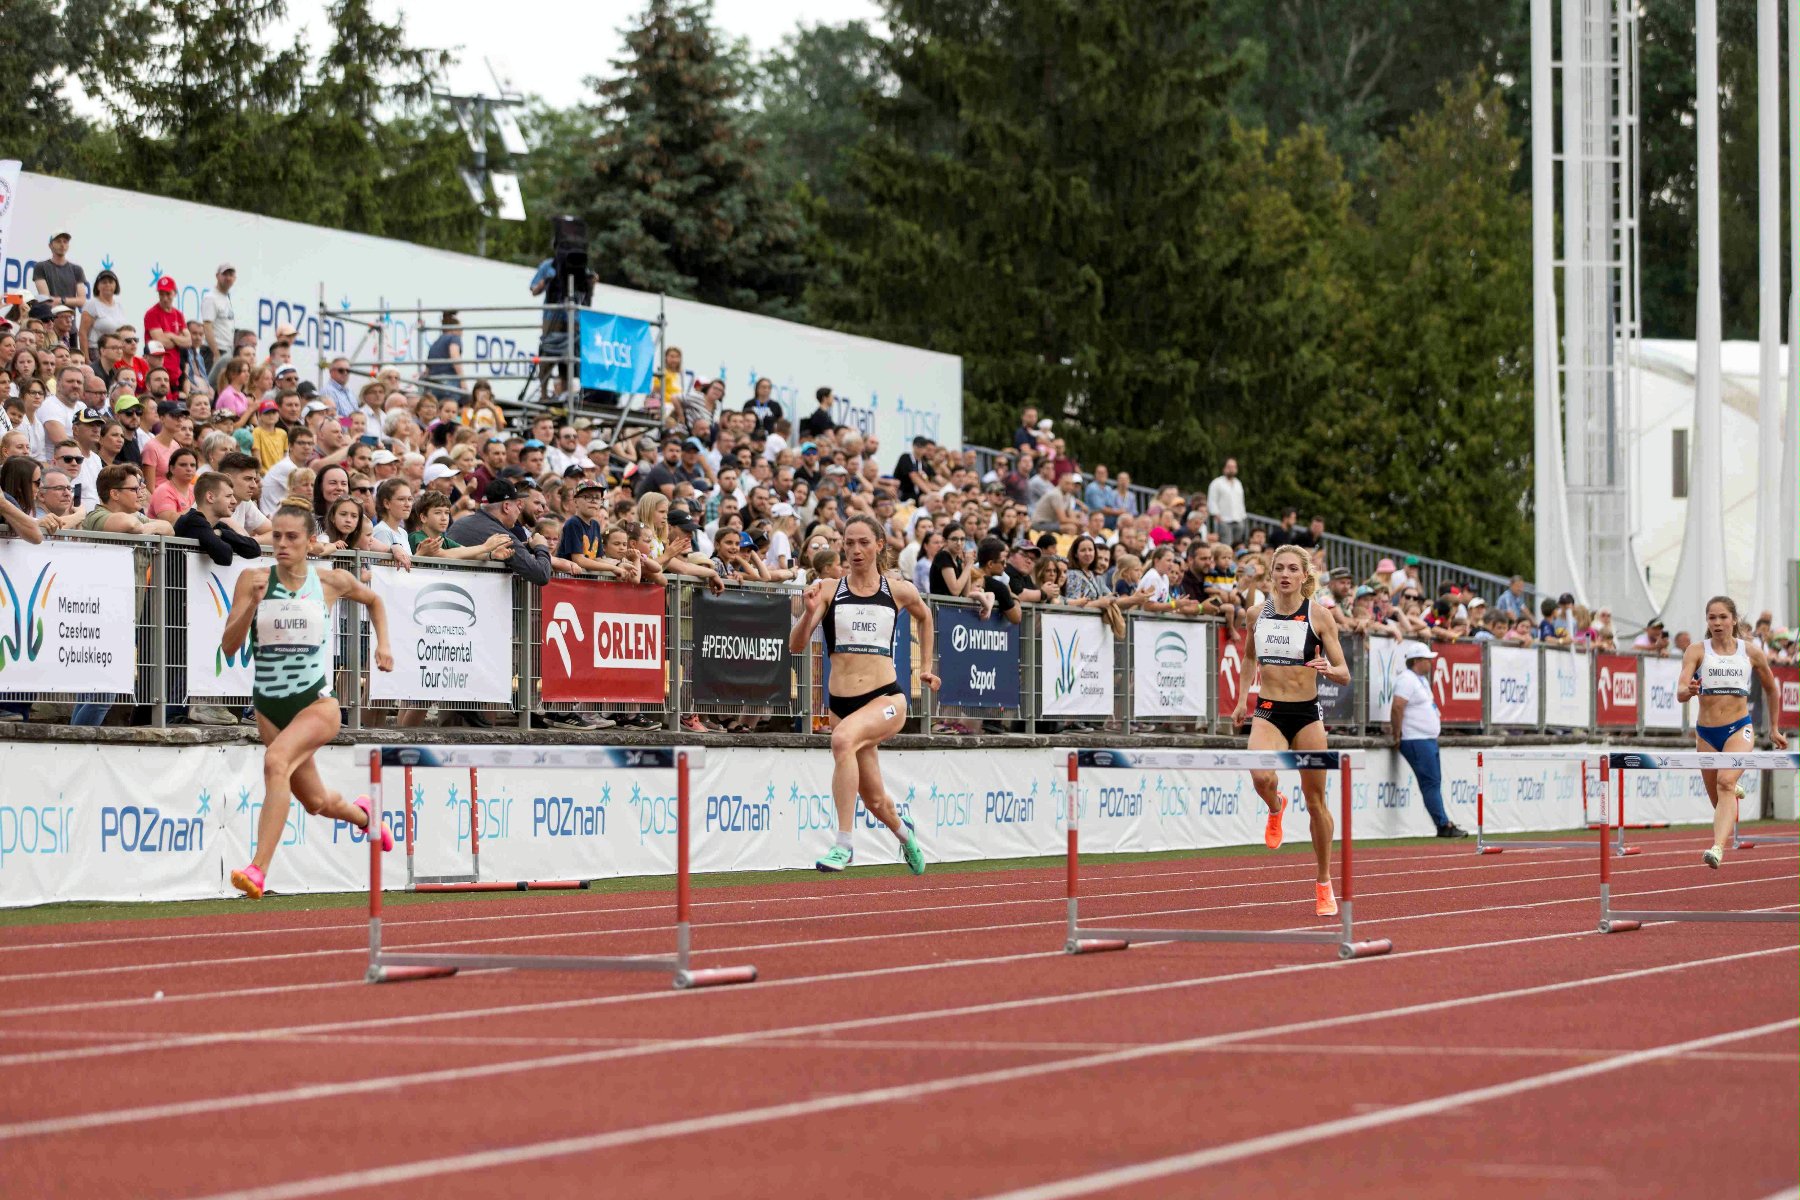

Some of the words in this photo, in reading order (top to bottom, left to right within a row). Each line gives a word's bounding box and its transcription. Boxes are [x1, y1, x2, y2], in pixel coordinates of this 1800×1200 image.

[58, 596, 100, 615] Memoriał
[58, 622, 100, 640] Czesława
[274, 618, 307, 629] OLIVIERI
[425, 625, 441, 634] WORLD
[852, 621, 877, 632] DEMES
[416, 638, 472, 663] Continental
[598, 621, 657, 660] ORLEN
[702, 634, 784, 662] #PERSONALBEST
[969, 629, 1008, 651] HYUNDAI
[58, 646, 112, 667] Cybulskiego
[420, 665, 440, 688] Tour
[441, 665, 468, 689] Silver
[970, 664, 996, 695] Szpot
[1455, 669, 1478, 693] ORLEN
[1708, 667, 1743, 677] SMOLIŃSKA
[1615, 677, 1634, 699] ORLEN
[0, 793, 74, 868] posir
